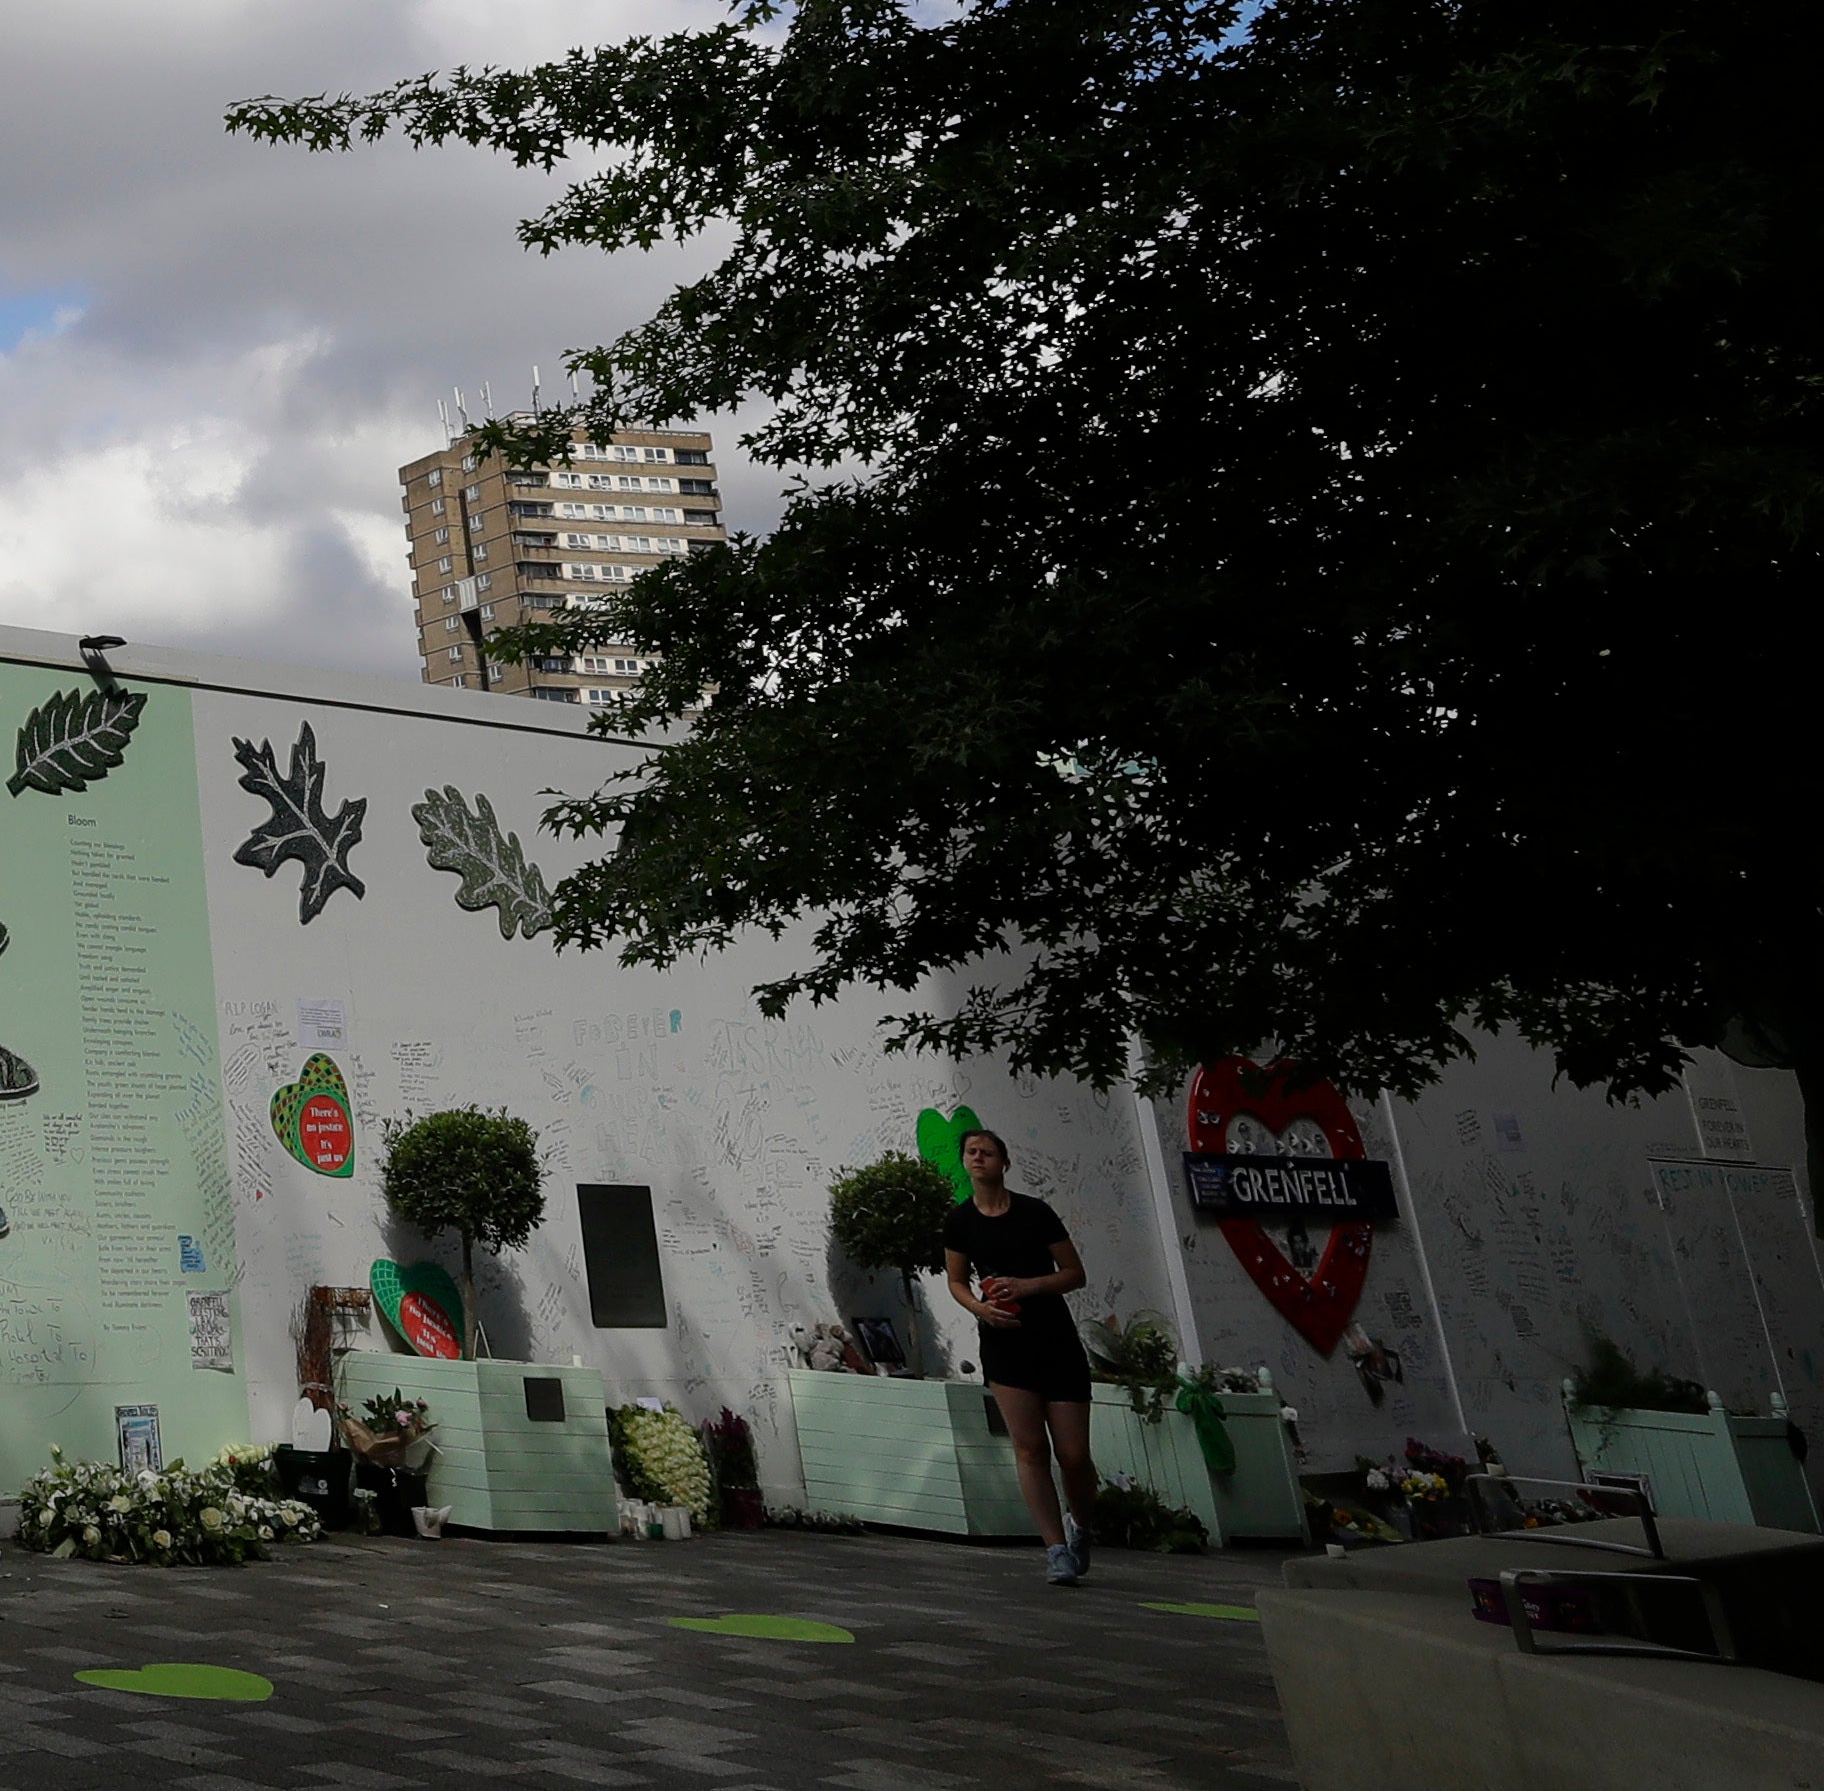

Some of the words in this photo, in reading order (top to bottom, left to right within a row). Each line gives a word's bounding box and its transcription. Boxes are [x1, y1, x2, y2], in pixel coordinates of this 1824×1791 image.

[67, 813, 97, 827] Bloom
[224, 1001, 247, 1016] RIP
[1698, 1096, 1738, 1113] GRENFELL
[309, 1106, 339, 1119] There's
[306, 1123, 318, 1132] no
[318, 1122, 344, 1134] justice
[1702, 1119, 1737, 1134] FOREVER
[320, 1139, 333, 1151] It's
[1704, 1135, 1722, 1149] OUR
[1722, 1137, 1751, 1151] HEARTS
[316, 1152, 331, 1165] just
[332, 1153, 344, 1163] us
[1231, 1166, 1358, 1208] GRENFELL
[1658, 1168, 1693, 1192] REST
[1699, 1169, 1714, 1187] IN
